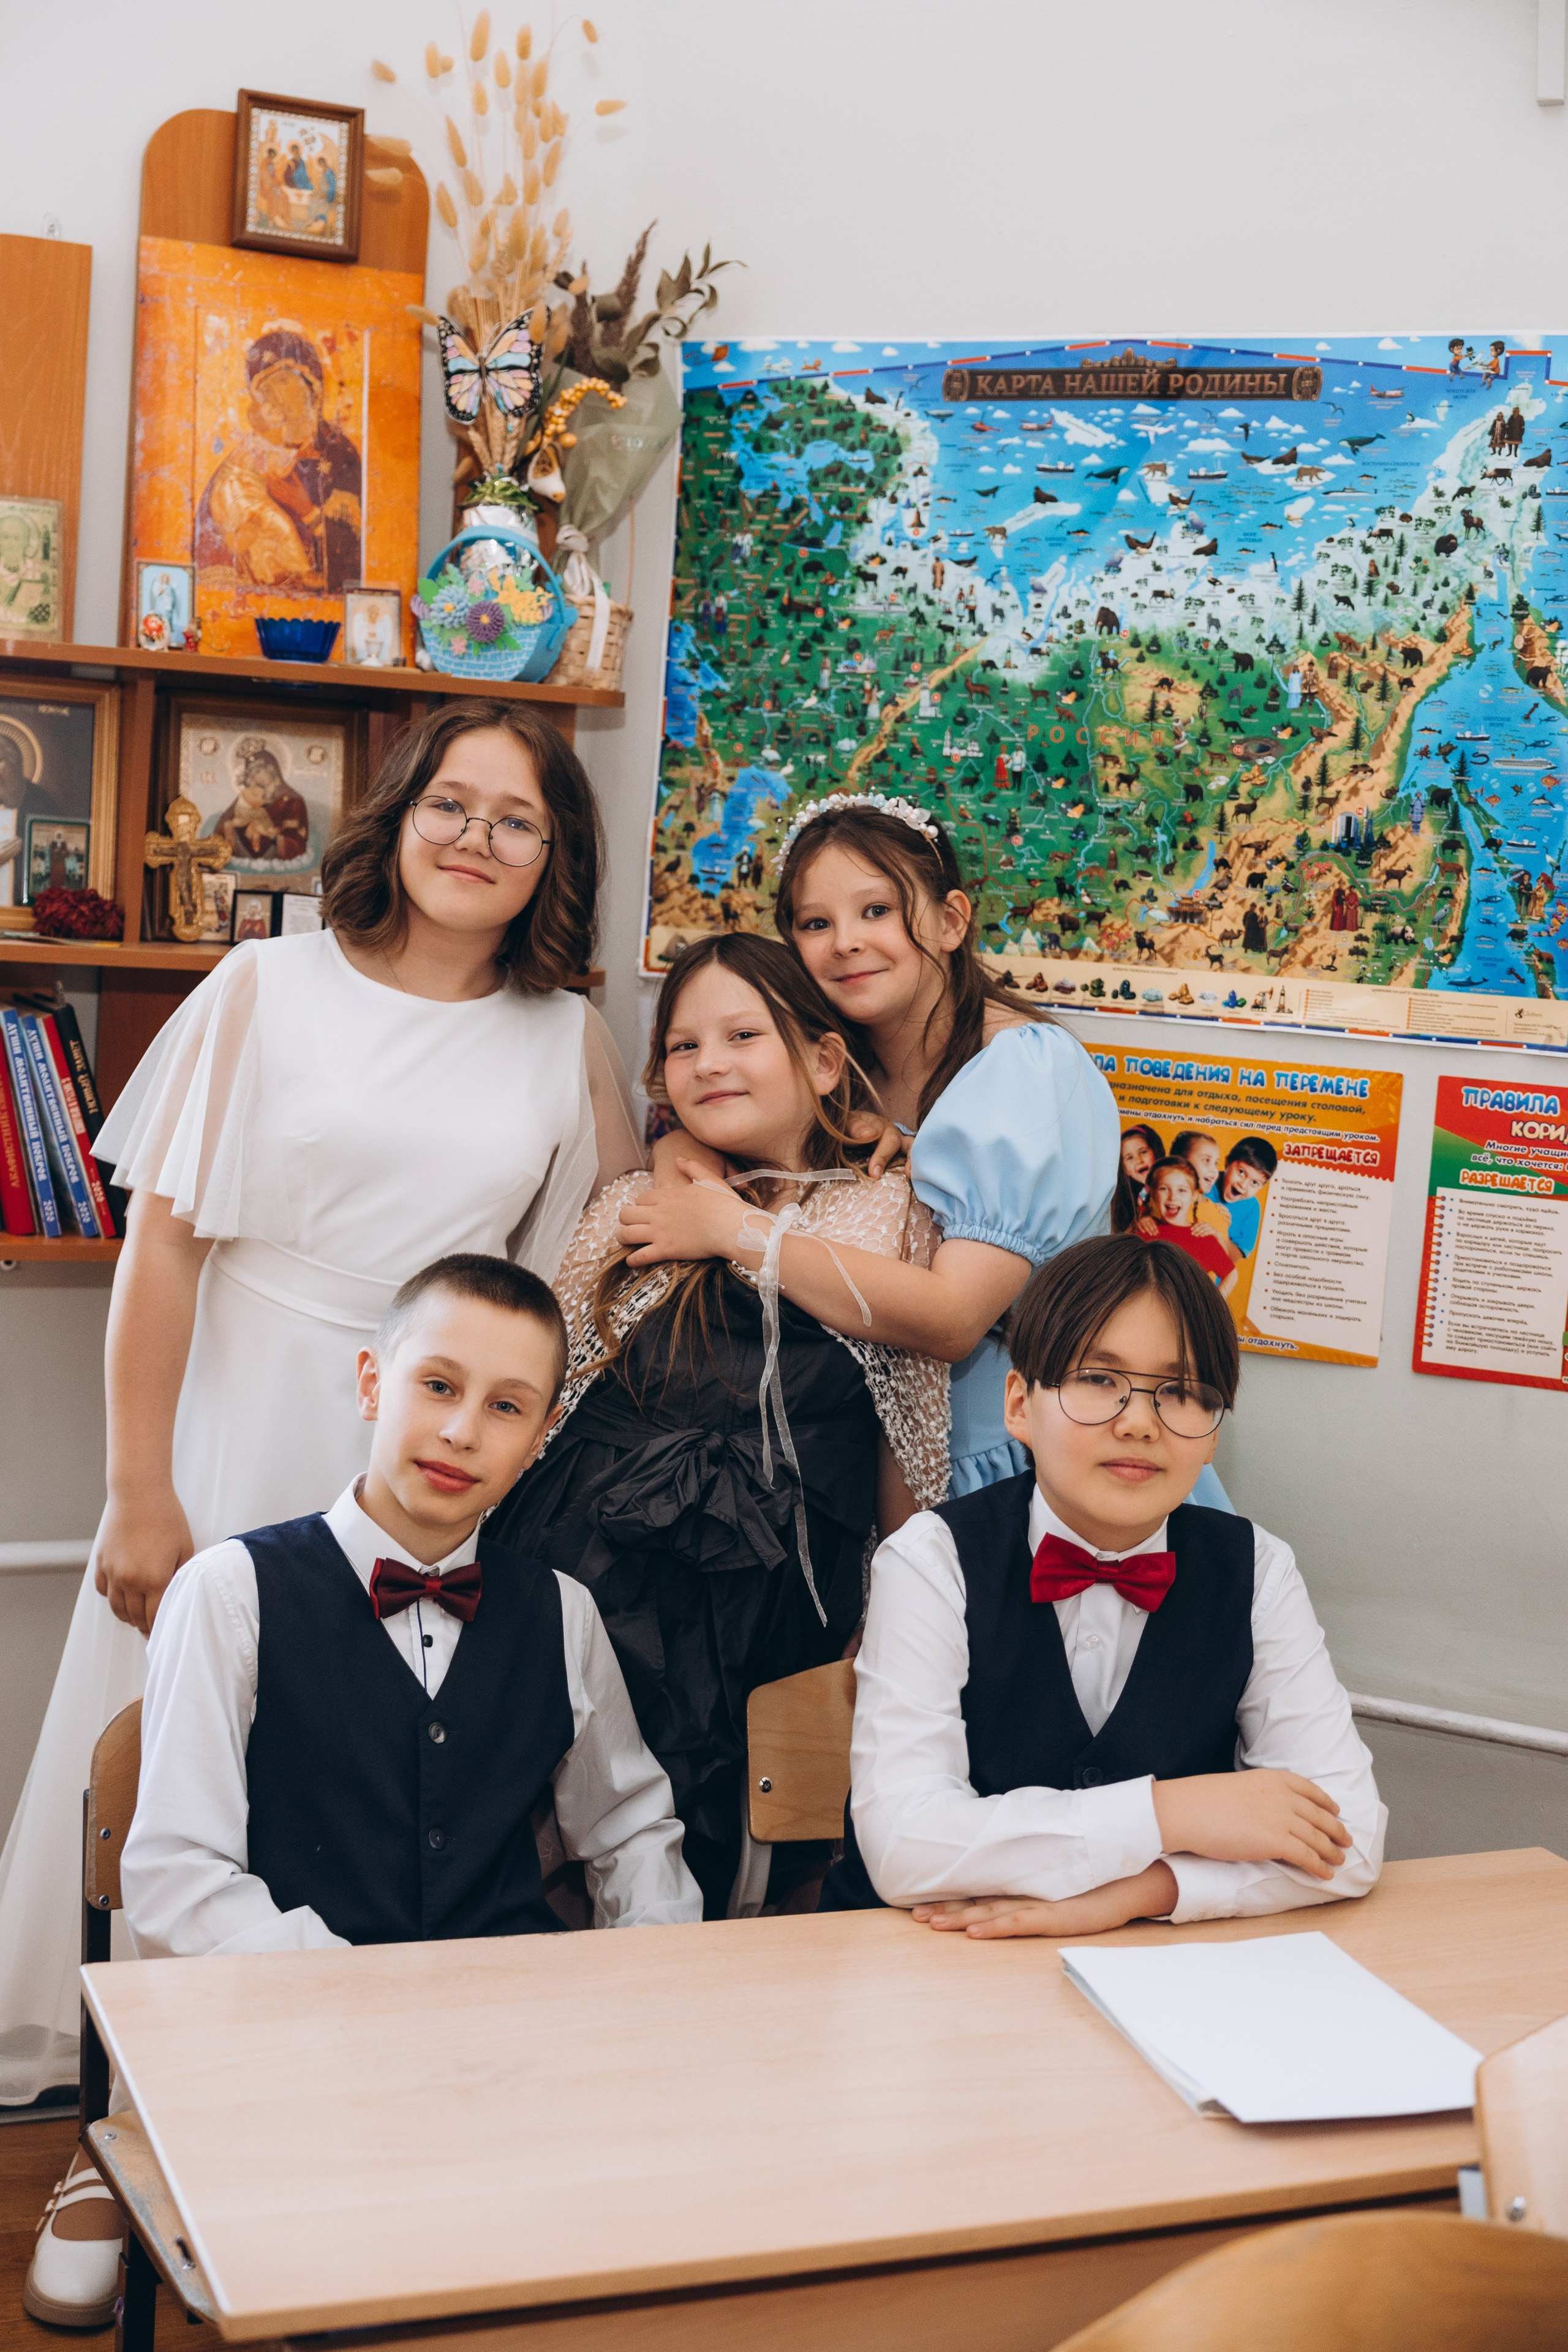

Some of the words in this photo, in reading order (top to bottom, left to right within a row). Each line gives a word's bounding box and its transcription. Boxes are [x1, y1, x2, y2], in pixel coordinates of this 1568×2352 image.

[975, 374, 1057, 396] КАРТА
[1063, 368, 1161, 396] НАШЕЙ
[1167, 373, 1289, 397] РОДИНЫ
[1027, 725, 1163, 747] РОССИЯ
[69, 1039, 87, 1072] ЗАВЕТ
[1125, 1057, 1231, 1083] ПОВЕДЕНИЯ
[1238, 1068, 1265, 1087] НА
[1274, 1071, 1370, 1098] ПЕРЕМЕНЕ
[77, 1072, 99, 1115] НОВЫЙ
[1174, 1087, 1193, 1096] для
[1197, 1090, 1241, 1102] отдыха,
[1245, 1095, 1308, 1108] посещения
[1311, 1102, 1366, 1115] столовой,
[1462, 1087, 1559, 1115] ПРАВИЛА
[1128, 1096, 1191, 1108] подготовки
[1203, 1104, 1276, 1120] следующему
[1280, 1111, 1316, 1123] уроку.
[1144, 1111, 1185, 1123] отдохнуть
[1195, 1116, 1237, 1126] набраться
[1256, 1123, 1282, 1132] перед
[1284, 1126, 1341, 1137] предстоящим
[1343, 1132, 1379, 1142] уроком.
[1284, 1144, 1378, 1164] ЗАПРЕЩАЕТСЯ
[1485, 1140, 1527, 1153] Многие
[1531, 1148, 1568, 1158] учащи
[1472, 1153, 1492, 1163] всё,
[1517, 1160, 1563, 1170] хочется:
[92, 1180, 105, 1203] 2020
[1461, 1170, 1553, 1193] РАЗРЕШАЕТСЯ
[43, 1199, 56, 1223] 2020
[78, 1200, 91, 1223] 2020
[1248, 1337, 1297, 1350] отдохнуть.
